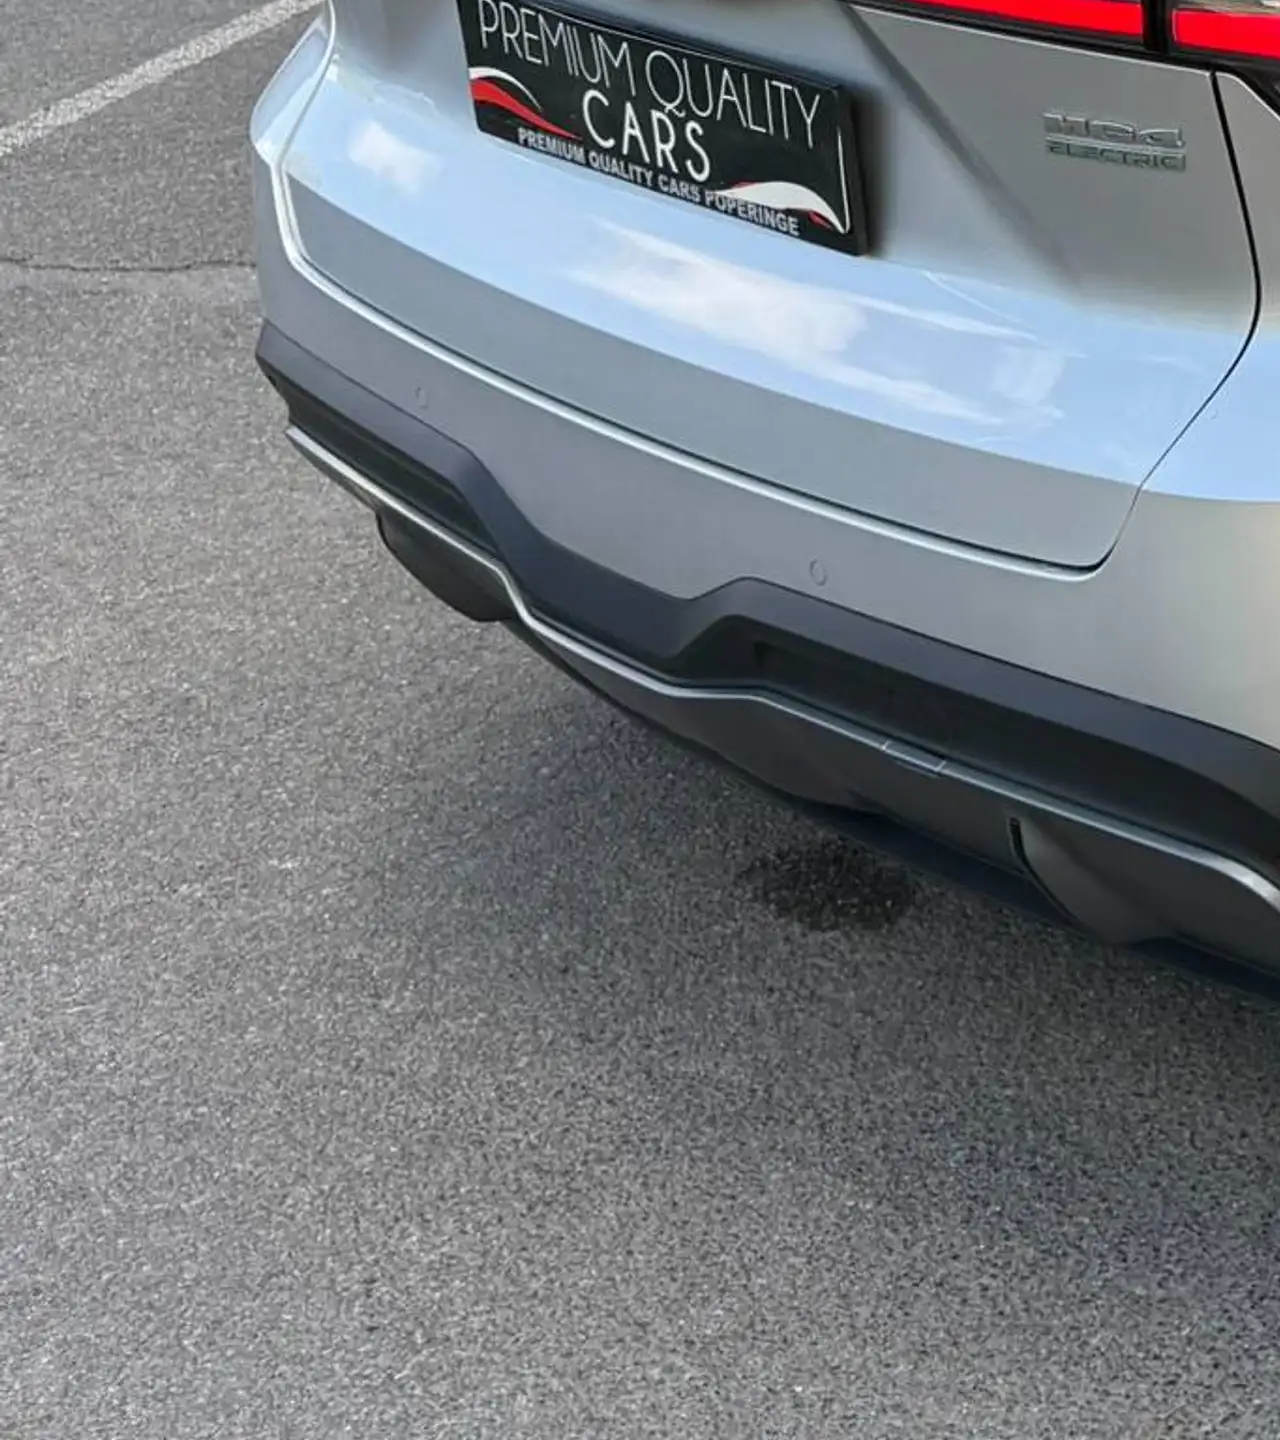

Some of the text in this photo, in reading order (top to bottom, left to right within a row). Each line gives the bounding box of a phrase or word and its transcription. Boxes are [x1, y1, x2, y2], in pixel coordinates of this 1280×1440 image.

[581, 89, 711, 183] CARS
[645, 49, 821, 149] QUALITY
[517, 126, 800, 237] PREMIUM QUALITY CARS POPERINGE
